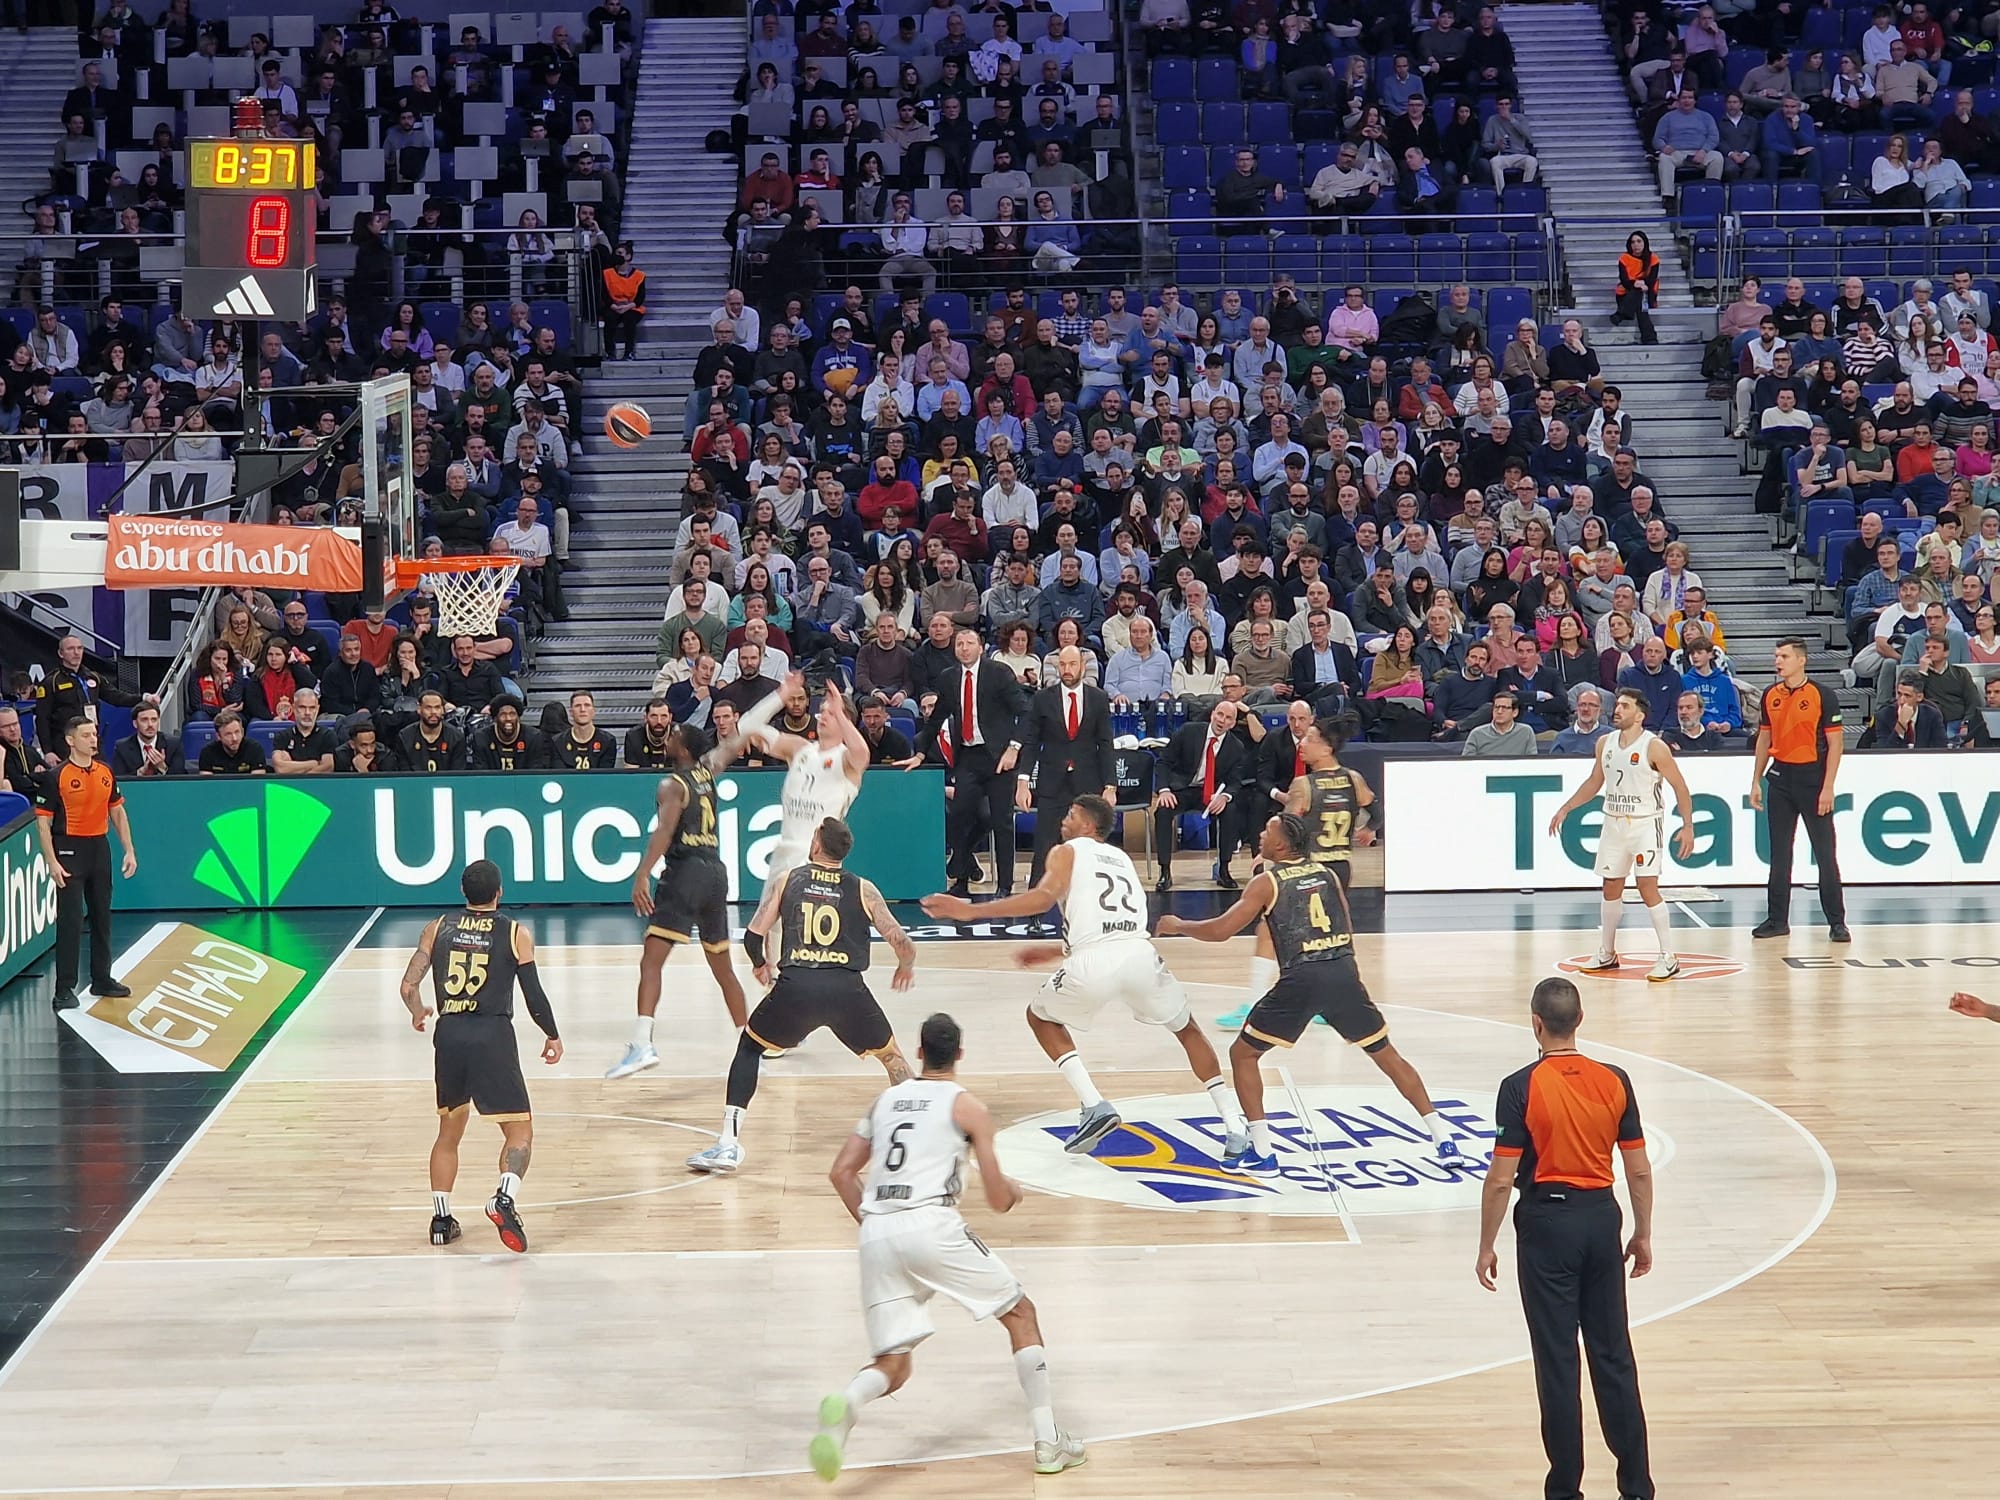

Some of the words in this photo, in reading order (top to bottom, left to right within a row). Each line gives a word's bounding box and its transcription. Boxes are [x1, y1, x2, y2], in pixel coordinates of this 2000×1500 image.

[215, 147, 297, 184] 8:37
[250, 199, 289, 266] 8
[150, 472, 209, 521] M
[114, 540, 190, 573] abu
[501, 757, 514, 771] 13
[575, 757, 591, 770] 26
[1117, 776, 1140, 787] rates
[1615, 769, 1624, 787] 7
[1606, 793, 1642, 804] mirates
[374, 780, 783, 902] Unicja
[1316, 810, 1352, 848] 32
[810, 868, 841, 884] THEIS
[1095, 871, 1138, 914] 22
[457, 915, 494, 932] JAMES
[801, 902, 841, 946] 10
[1308, 892, 1332, 933] 4
[444, 950, 490, 996] 55
[790, 948, 849, 965] MONACO
[128, 941, 269, 1048] ETIHAD
[886, 1122, 916, 1172] 6
